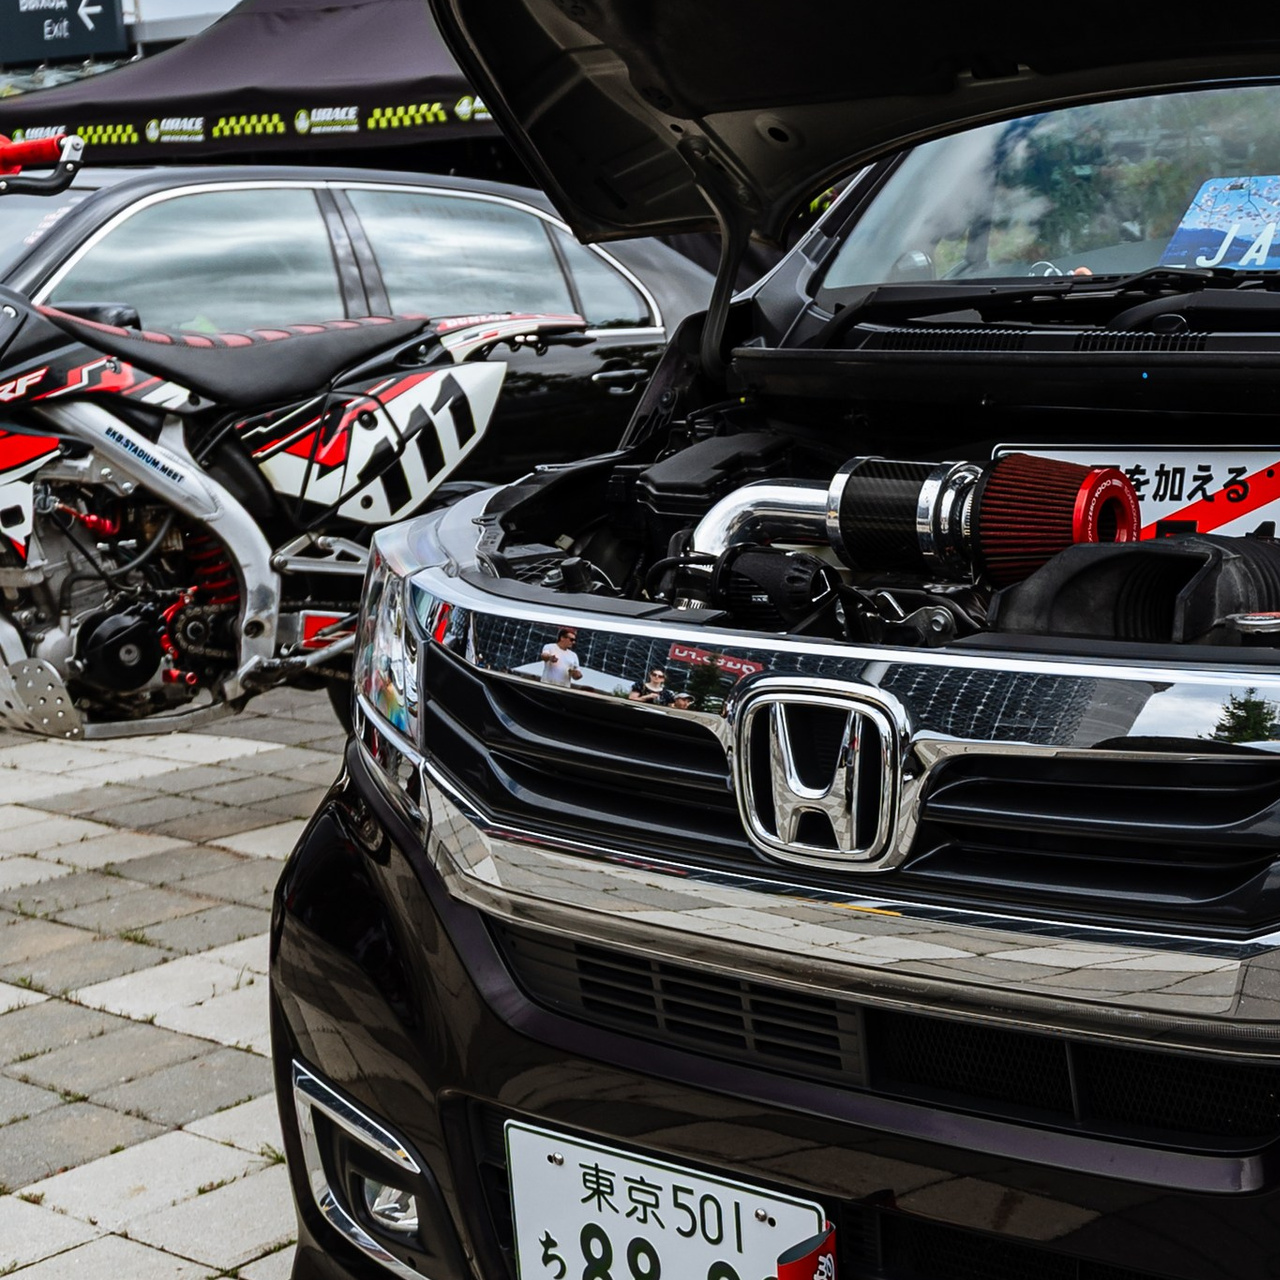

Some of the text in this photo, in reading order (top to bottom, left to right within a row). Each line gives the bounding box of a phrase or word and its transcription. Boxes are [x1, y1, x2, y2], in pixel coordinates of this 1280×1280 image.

[44, 17, 70, 40] Exit
[1091, 464, 1250, 503] を加える
